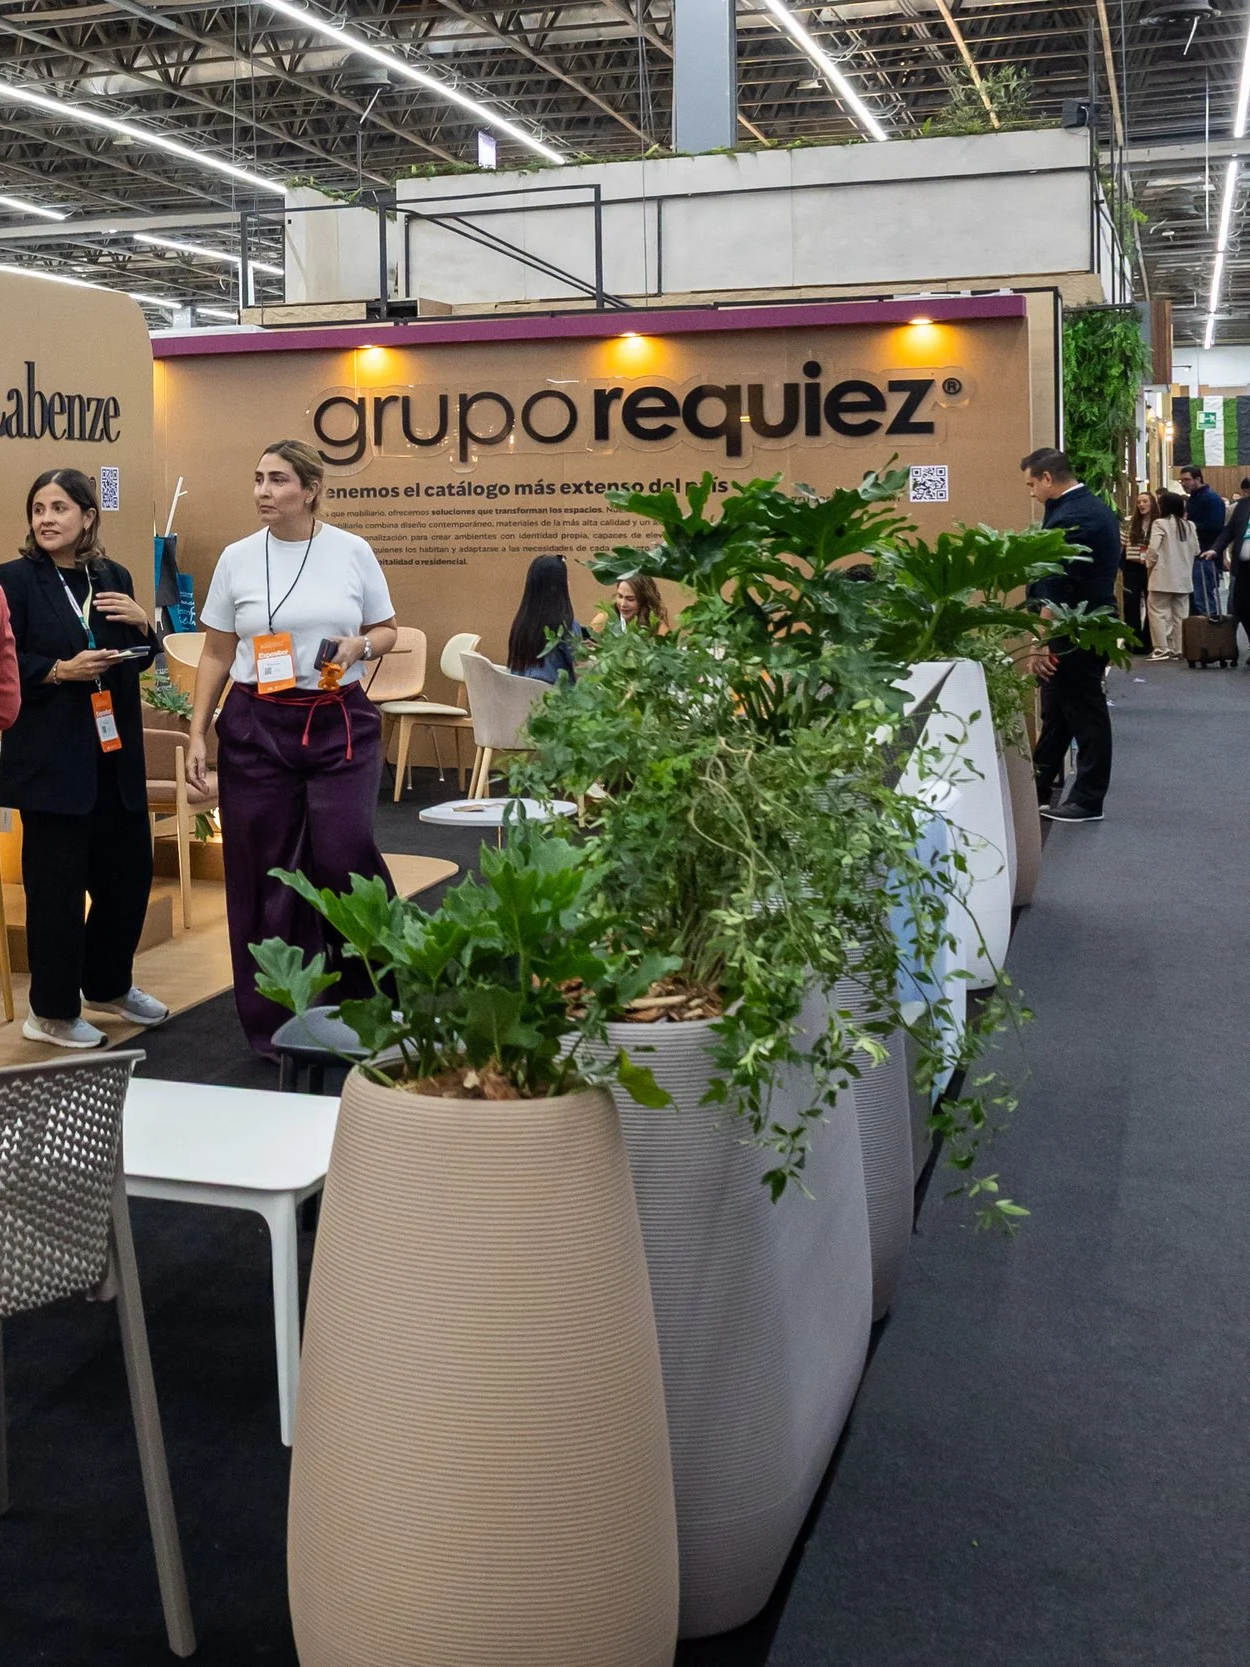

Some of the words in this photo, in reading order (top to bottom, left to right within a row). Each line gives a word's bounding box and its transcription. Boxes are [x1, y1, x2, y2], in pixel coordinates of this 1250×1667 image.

[313, 389, 579, 466] grupo
[327, 486, 400, 499] enemos
[404, 482, 420, 498] el
[424, 480, 510, 499] catálogo
[514, 479, 556, 495] más
[559, 478, 644, 495] extenso
[388, 508, 430, 516] ofrecemos
[431, 507, 476, 515] soluciones
[477, 508, 493, 516] que
[495, 506, 548, 515] transforman
[549, 506, 562, 514] los
[400, 521, 426, 529] diseño
[496, 519, 539, 527] materiales
[541, 519, 551, 527] de
[454, 532, 497, 540] ambientes
[519, 532, 558, 540] identidad
[592, 532, 628, 540] capaces
[451, 546, 456, 554] y
[459, 545, 498, 554] adaptarse
[522, 544, 573, 552] necesidades
